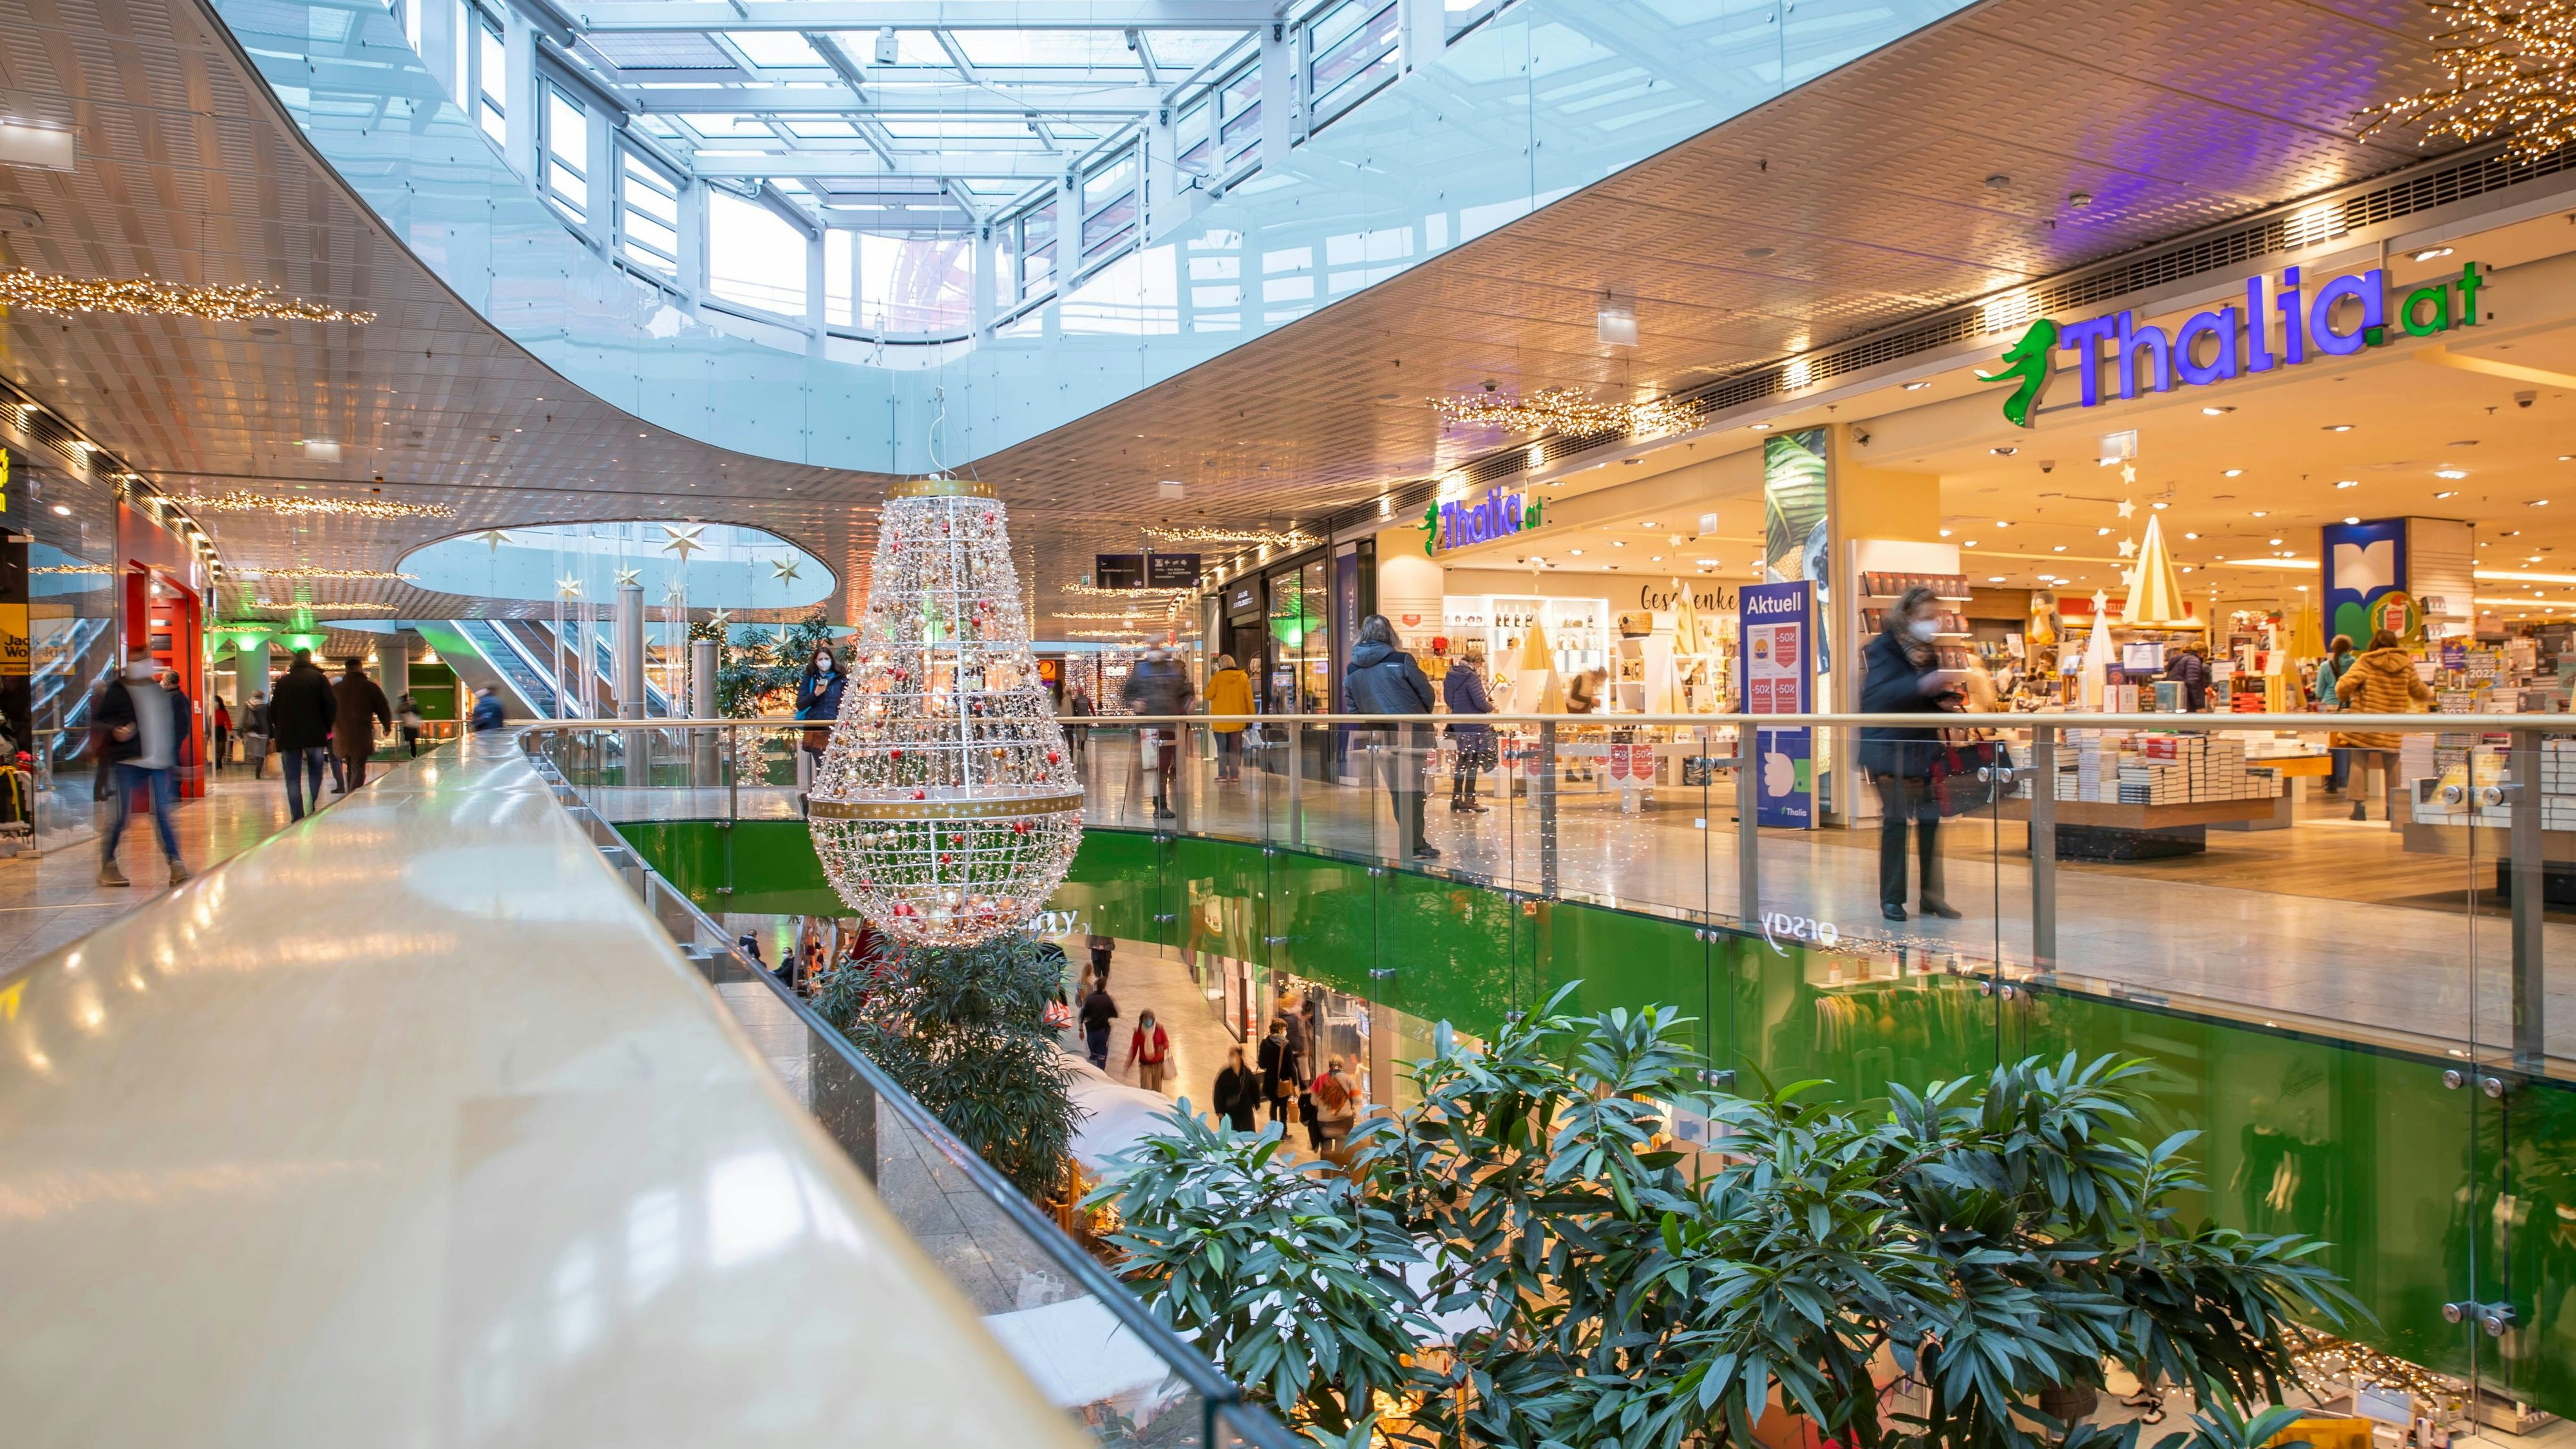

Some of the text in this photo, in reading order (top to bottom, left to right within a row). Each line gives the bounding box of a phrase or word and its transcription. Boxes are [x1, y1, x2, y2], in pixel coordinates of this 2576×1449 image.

[1747, 592, 1801, 614] Aktuell
[1776, 632, 1795, 643] -50%
[2469, 669, 2496, 678] 2022
[1752, 685, 1770, 694] -50%
[1776, 685, 1795, 694] -50%
[1786, 808, 1807, 817] Thalia
